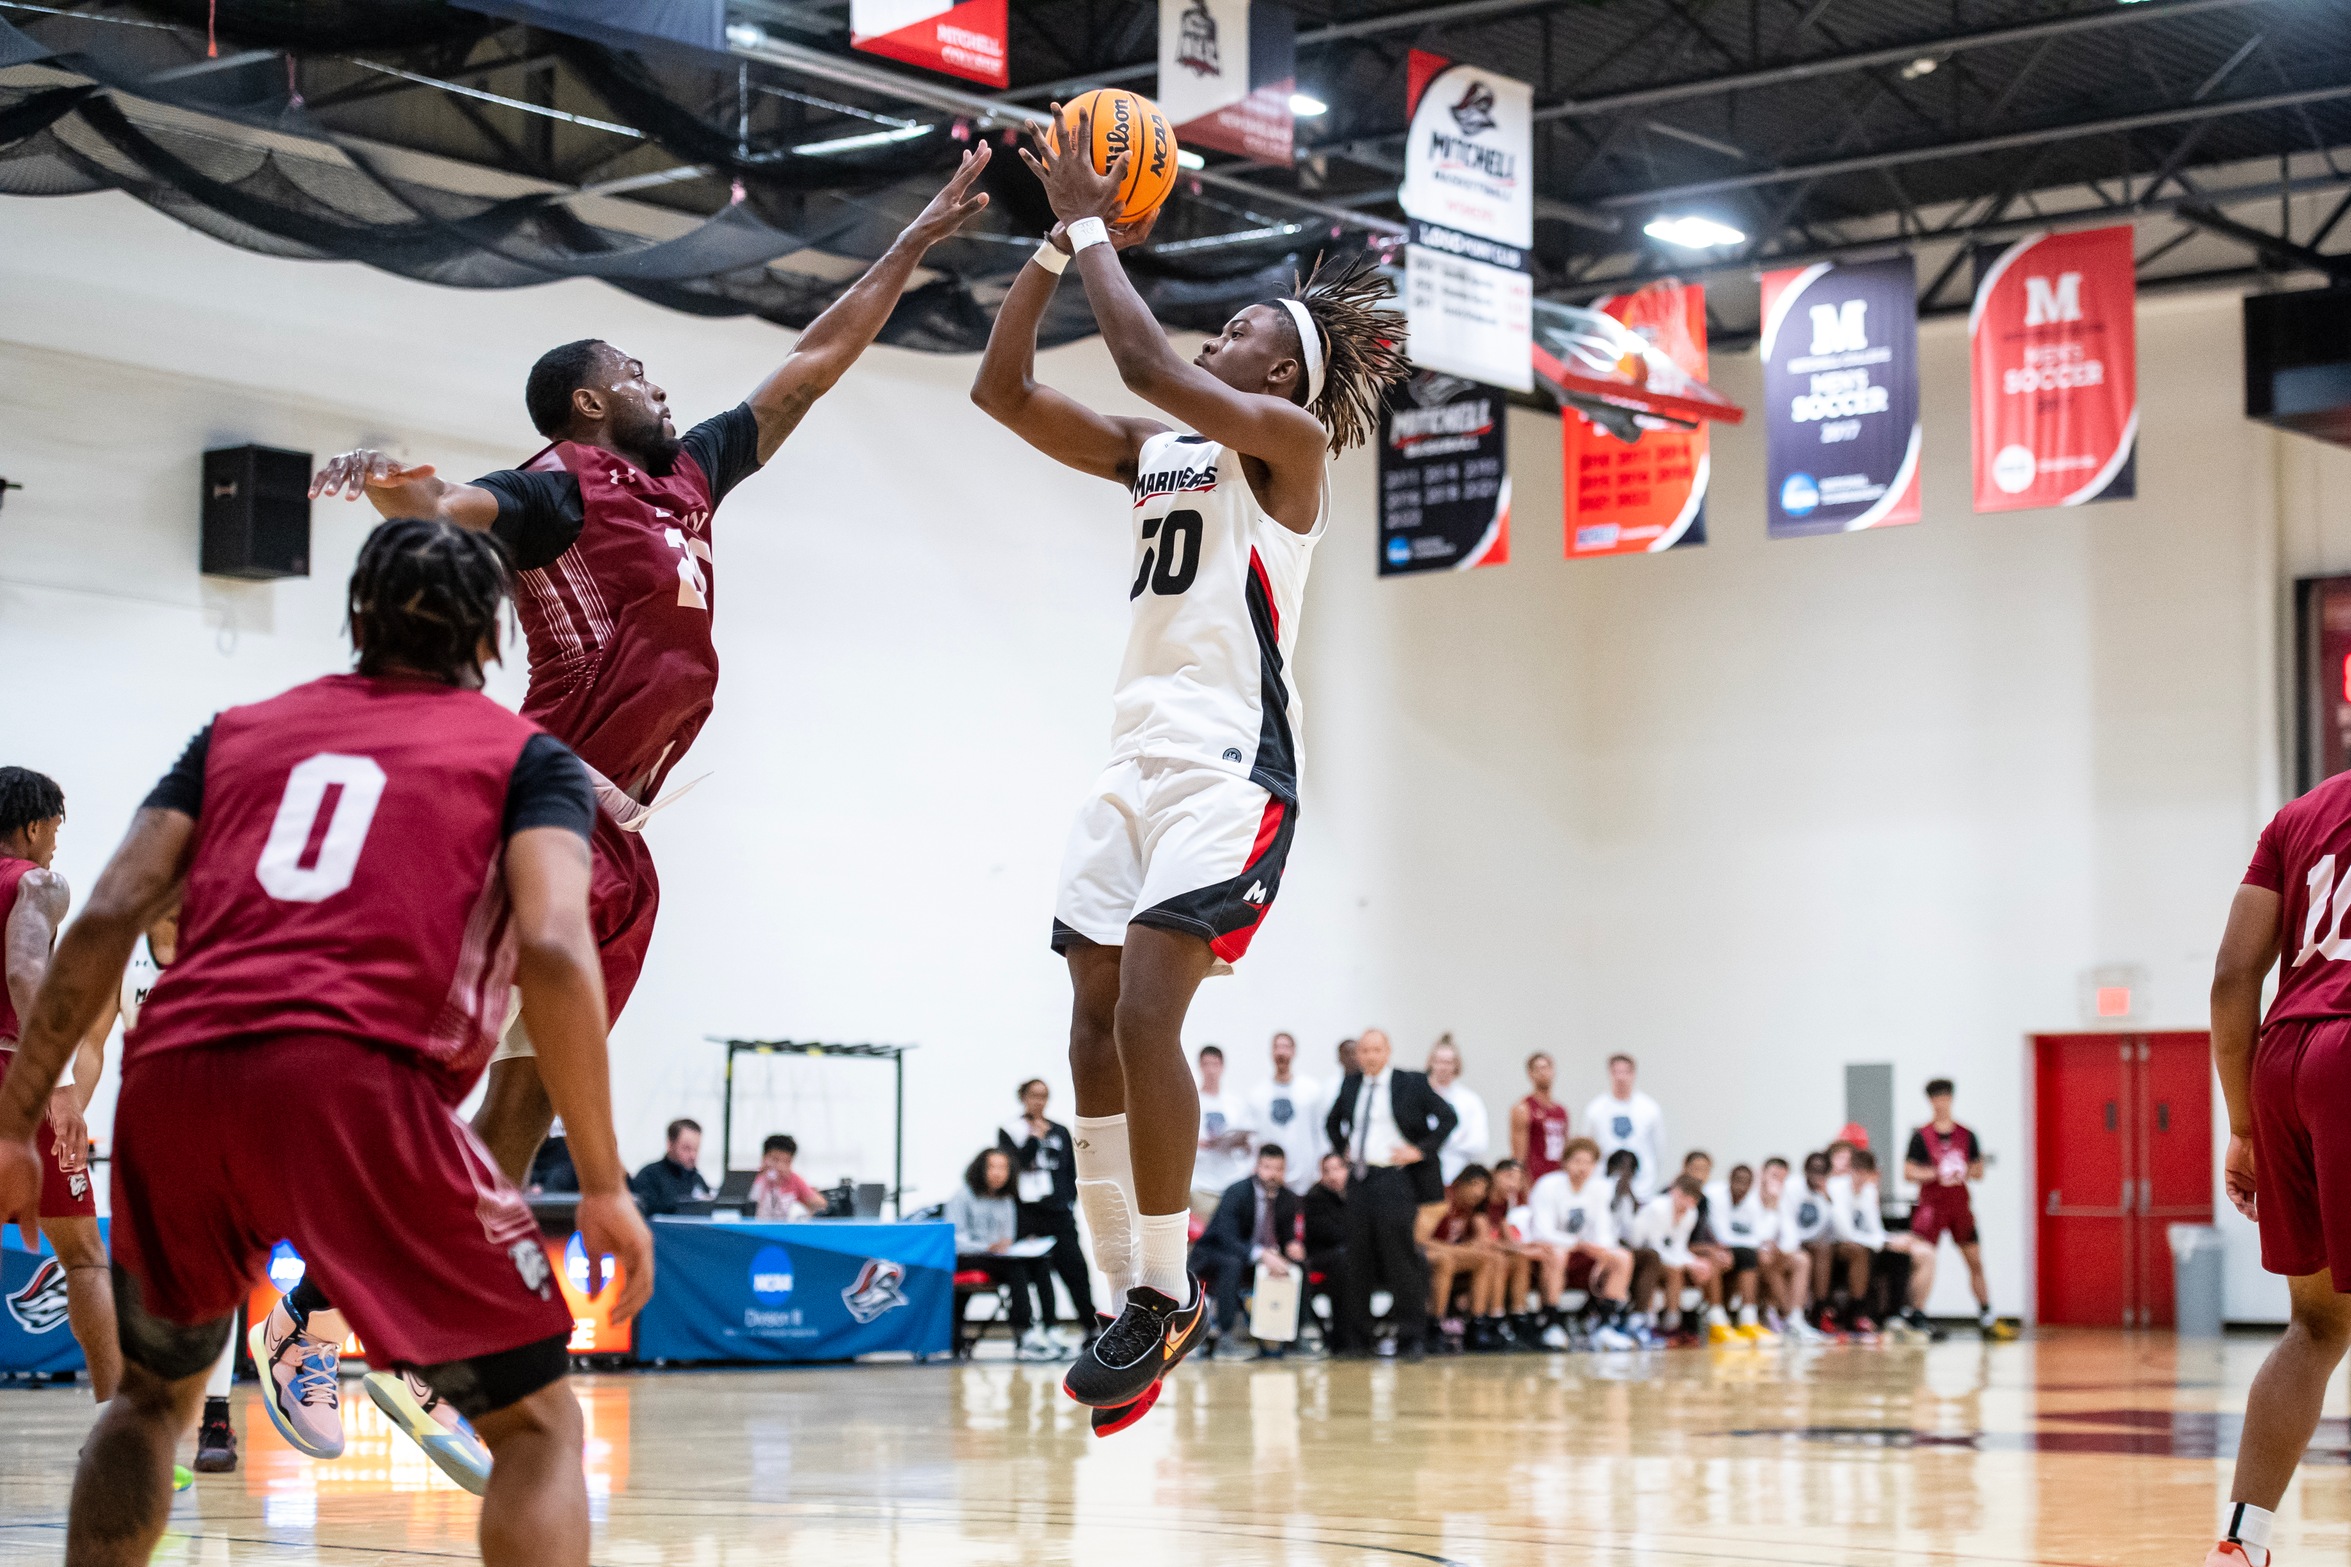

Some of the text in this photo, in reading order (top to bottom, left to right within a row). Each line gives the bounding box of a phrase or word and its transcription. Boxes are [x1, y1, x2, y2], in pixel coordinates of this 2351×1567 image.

[1150, 114, 1168, 178] NCAA
[1429, 131, 1515, 177] MITCHELL
[2025, 272, 2083, 327] M
[1809, 299, 1868, 355] M
[2004, 360, 2104, 394] SOCCER
[1389, 400, 1491, 443] MITCHELL
[1791, 386, 1889, 422] SOCCER
[256, 752, 387, 903] 0
[1243, 879, 1266, 903] M
[753, 1274, 791, 1292] NCAA
[744, 1308, 790, 1328] Division
